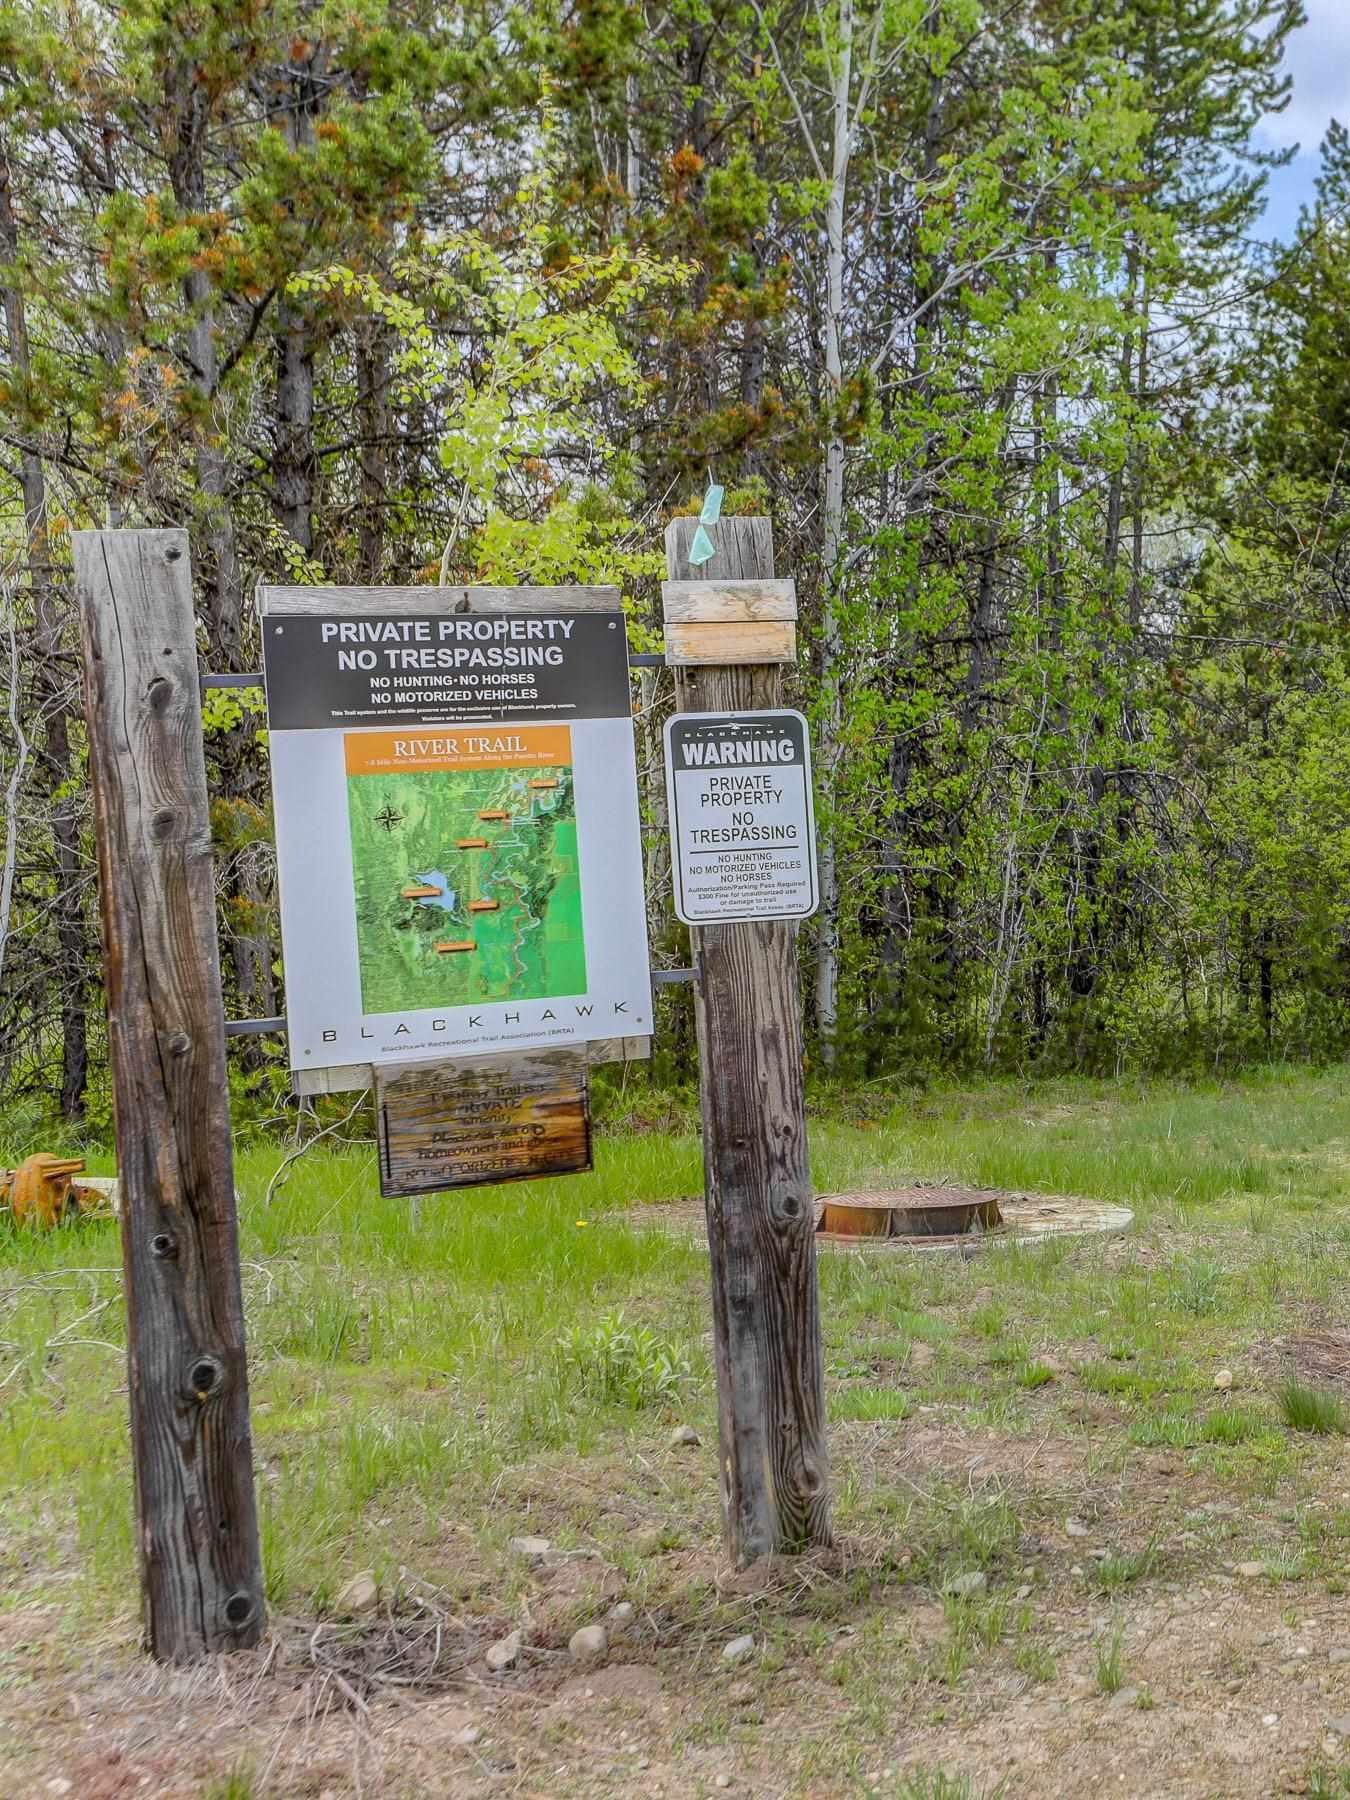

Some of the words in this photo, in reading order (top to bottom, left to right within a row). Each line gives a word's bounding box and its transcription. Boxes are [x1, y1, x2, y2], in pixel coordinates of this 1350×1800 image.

[321, 621, 432, 643] PRIVATE
[439, 619, 575, 641] PROPERTY
[337, 650, 377, 671] NO
[384, 646, 564, 669] TRESPASSING
[370, 677, 390, 688] NO
[394, 676, 452, 687] HUNTING
[459, 675, 479, 685] NO
[482, 674, 535, 684] HORSES
[371, 693, 391, 704] NO
[395, 691, 472, 703] MOTORIZED
[475, 689, 538, 700] VEHICLES
[393, 738, 460, 757] RIVER
[464, 735, 528, 753] TRAIL
[682, 739, 795, 765] WARNING
[710, 775, 772, 791] PRIVATE
[700, 790, 783, 807] PROPERTY
[732, 812, 754, 826] NO
[691, 825, 797, 843] TRESPASSING
[718, 855, 731, 863] NO
[733, 853, 772, 862] HUNTING
[690, 867, 702, 875] NO
[705, 863, 756, 874] MOTORIZED
[759, 860, 801, 871] VEHICLES
[721, 874, 733, 883] NO
[736, 872, 772, 882] HORSES
[323, 1001, 628, 1042] BLACKHAWK
